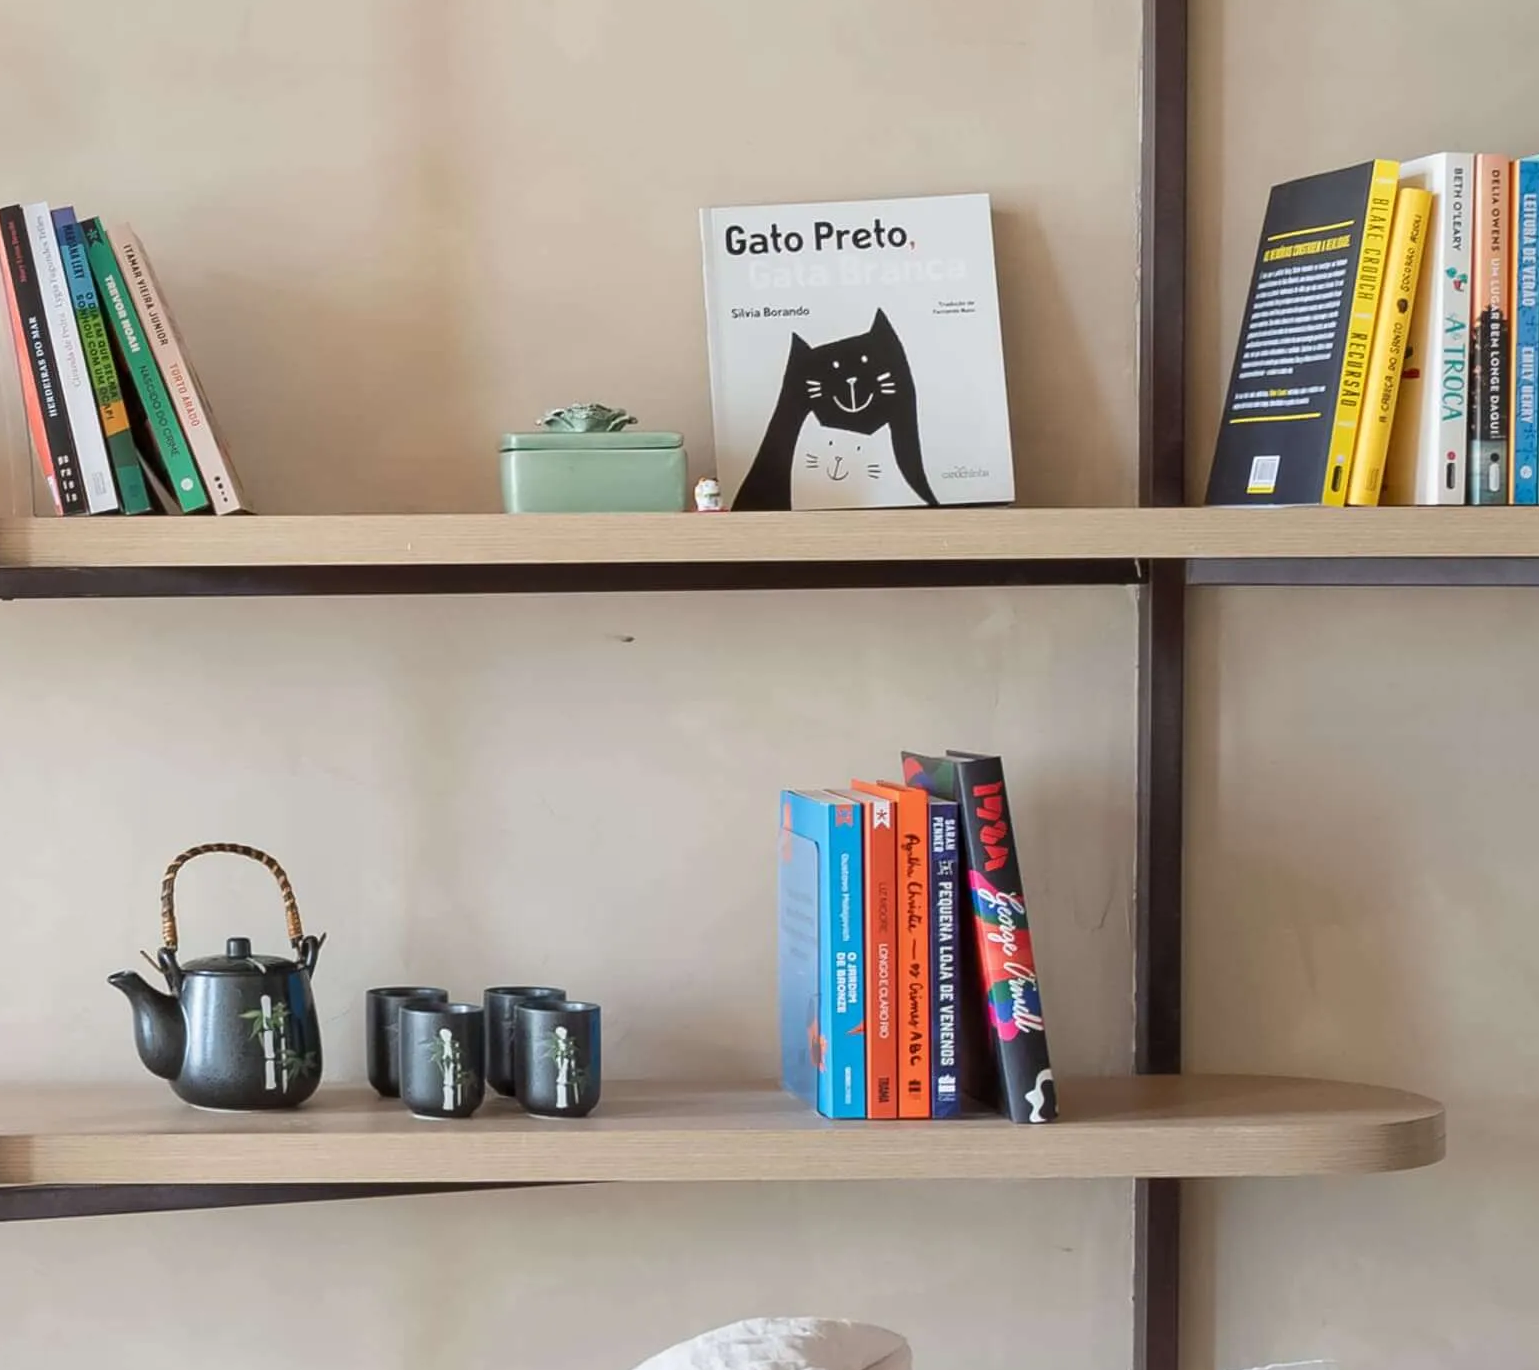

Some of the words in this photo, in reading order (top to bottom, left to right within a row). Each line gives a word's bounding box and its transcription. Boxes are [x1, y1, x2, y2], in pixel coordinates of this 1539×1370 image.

[1453, 167, 1463, 198] BETH
[1491, 169, 1501, 205] DELIA
[725, 224, 804, 255] Gato
[813, 219, 916, 251] Preto,
[1366, 197, 1389, 241] BLAKE
[1452, 201, 1463, 251] O'LEARY
[1491, 208, 1501, 252] OWENS
[1523, 193, 1537, 246] LEITURA
[1400, 248, 1415, 292] SOCORRO
[1410, 214, 1422, 243] ACIOLI
[1491, 258, 1500, 277] UM
[1522, 248, 1536, 264] DE
[749, 257, 828, 291] Gata
[838, 256, 967, 287] Branca
[1357, 248, 1381, 301] CROUCH
[1522, 265, 1536, 307] VERÃO
[86, 292, 94, 300] O
[87, 302, 99, 319] DIA
[104, 274, 128, 318] TREVOR
[120, 318, 141, 353] NOAH
[123, 244, 142, 279] ITAMAR
[137, 279, 154, 311] VIEIRA
[148, 311, 169, 346] JUNIOR
[731, 307, 760, 319] Silvia
[763, 306, 810, 318] Borando
[1490, 279, 1500, 320] LUGAR
[28, 316, 40, 340] MAR
[76, 294, 93, 339] SONHOU
[87, 339, 100, 366] COM
[94, 368, 107, 386] UM
[92, 319, 105, 337] EM
[1390, 322, 1403, 354] SANTO
[1445, 316, 1466, 333] A
[1490, 323, 1500, 348] BEM
[34, 341, 45, 357] DO
[98, 339, 110, 362] QUE
[1388, 357, 1398, 372] DO
[1521, 346, 1535, 382] EMILY
[103, 363, 119, 399] SELMA
[1340, 332, 1368, 407] RECURSÃO
[1442, 344, 1466, 422] TROCA
[1490, 351, 1500, 391] LONGE
[37, 359, 58, 418] HERDEIRAS
[169, 363, 187, 394] TORTO
[182, 393, 200, 427] ARADO
[1380, 375, 1394, 412] CABEÇA
[1521, 385, 1534, 423] HENRY
[140, 364, 161, 411] NASCIDO
[155, 410, 167, 426] DO
[161, 425, 181, 457] CRIME
[1490, 395, 1500, 435] DAQUI
[933, 816, 944, 853] PENNER
[944, 819, 956, 851] SARAH
[901, 833, 921, 879] Agatha
[907, 881, 923, 935] Christie
[938, 881, 954, 942] PEQUENA
[836, 952, 846, 967] DE
[847, 952, 857, 962] O
[878, 943, 889, 978] LONGO
[939, 946, 954, 980] LOJA
[978, 888, 1026, 957] George
[1003, 960, 1044, 1034] Orwell
[836, 969, 847, 1013] BRONZE
[847, 964, 858, 1004] JARDIM
[939, 984, 954, 1002] DE
[879, 987, 889, 1020] CLARO
[879, 1021, 890, 1039] RIO
[940, 1004, 955, 1067] VENENOS
